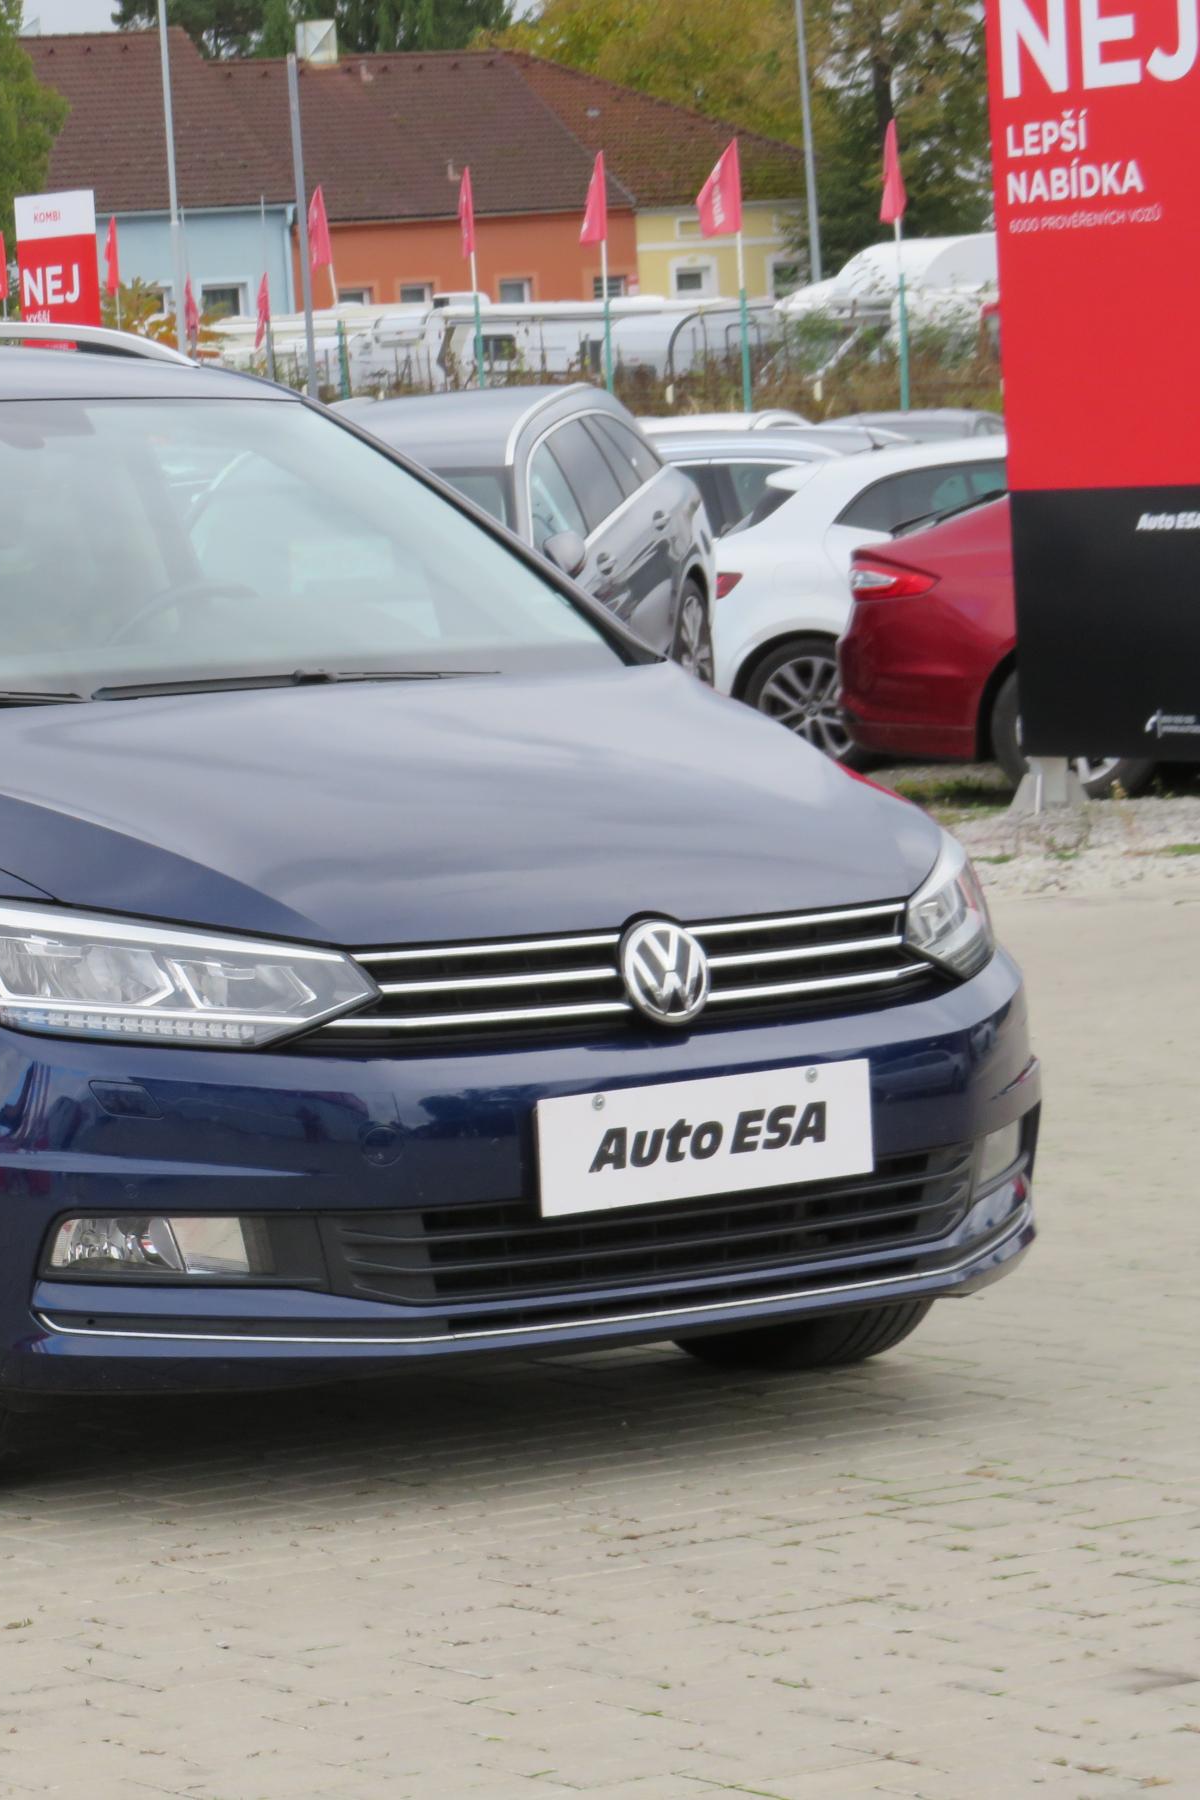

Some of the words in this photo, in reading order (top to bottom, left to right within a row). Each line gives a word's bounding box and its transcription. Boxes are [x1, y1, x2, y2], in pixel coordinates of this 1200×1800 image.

[999, 0, 1199, 99] NEJ
[1006, 108, 1088, 158] LEPŠÍ
[1006, 157, 1144, 205] NABÍDKA
[33, 210, 61, 224] KOMBI
[22, 263, 80, 308] NEJ
[1135, 512, 1176, 530] Auto
[588, 1118, 724, 1173] Auto
[729, 1100, 827, 1155] ESA
